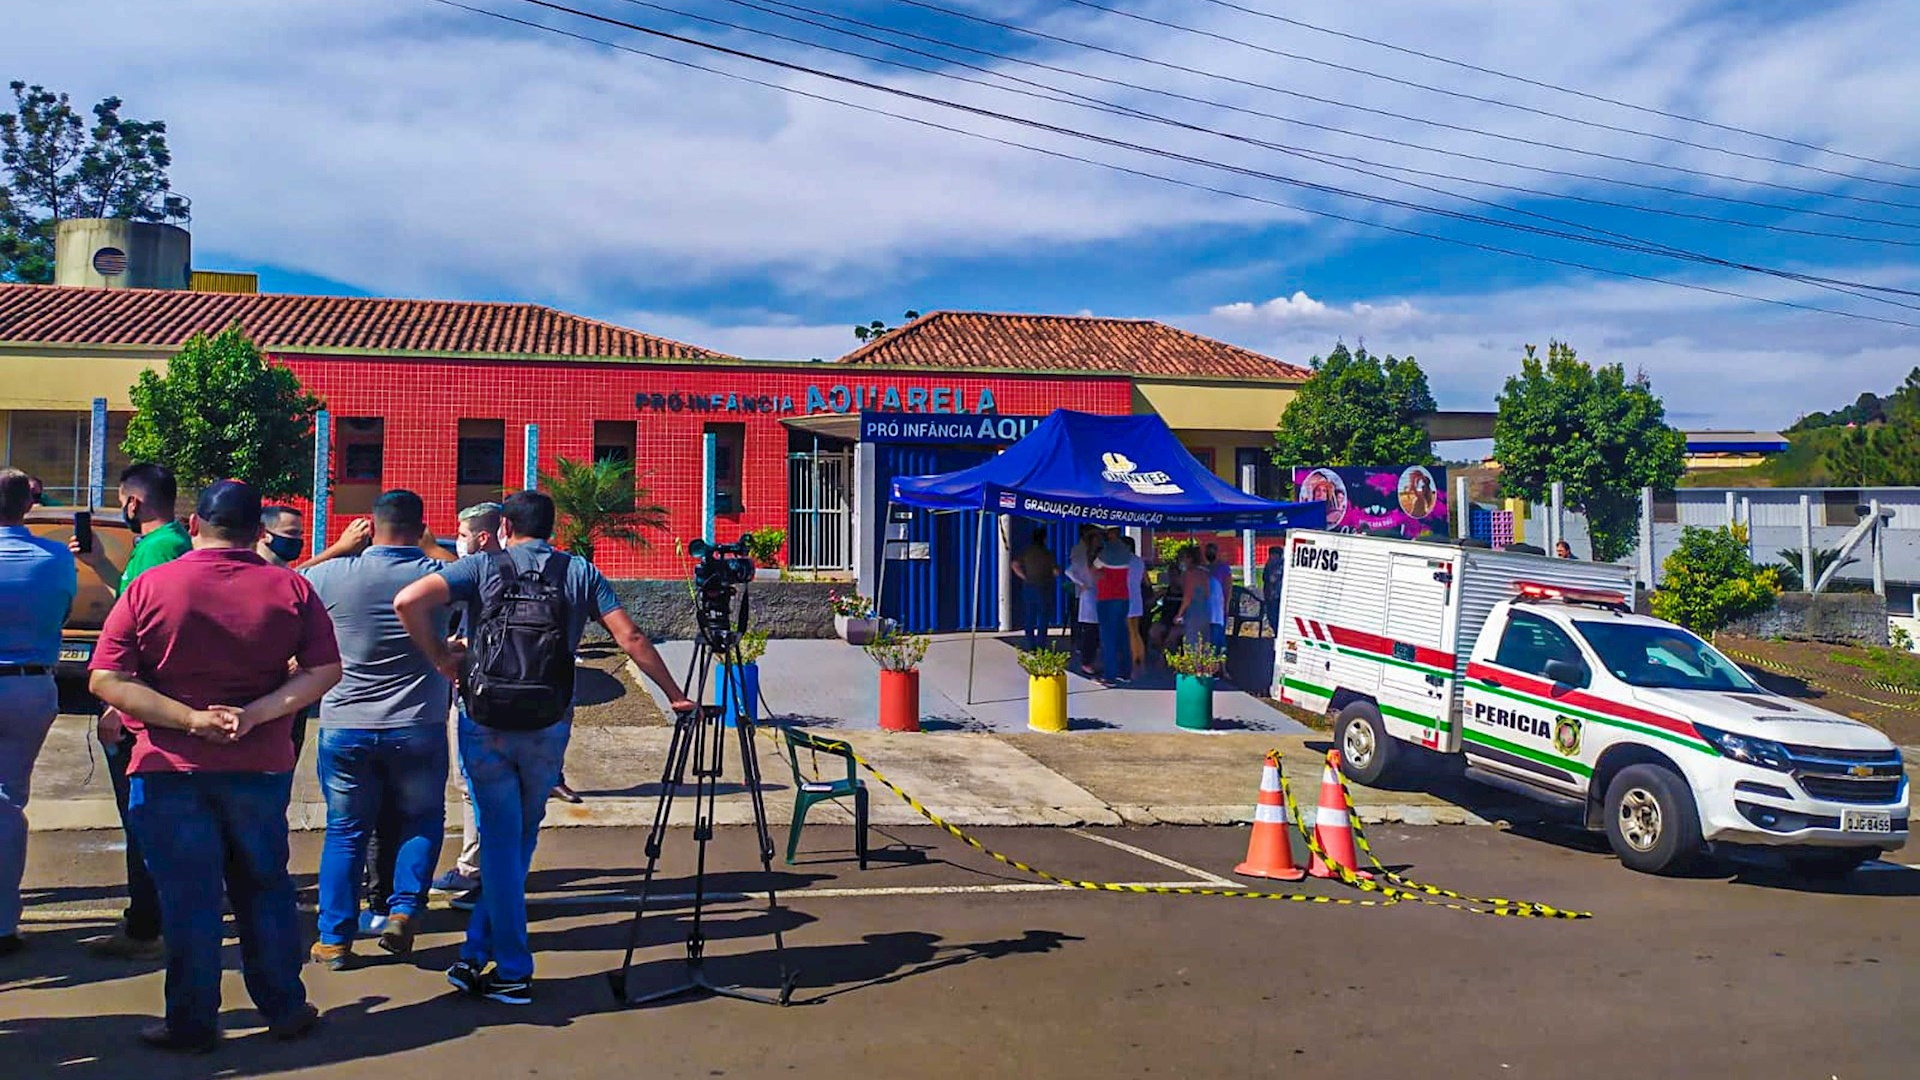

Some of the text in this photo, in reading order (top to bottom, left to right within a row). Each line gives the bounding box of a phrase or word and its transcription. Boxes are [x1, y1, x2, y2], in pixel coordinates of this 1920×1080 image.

[867, 419, 899, 437] PRÓ
[903, 420, 974, 438] INFÂNCIA
[1024, 498, 1081, 518] GRADUAÇÃO
[1081, 507, 1090, 518] E
[1089, 503, 1110, 519] PÓS
[1109, 510, 1163, 526] GRADUAÇÃO
[1296, 546, 1339, 572] IGP/SC
[1475, 702, 1551, 740] PERÍCIA
